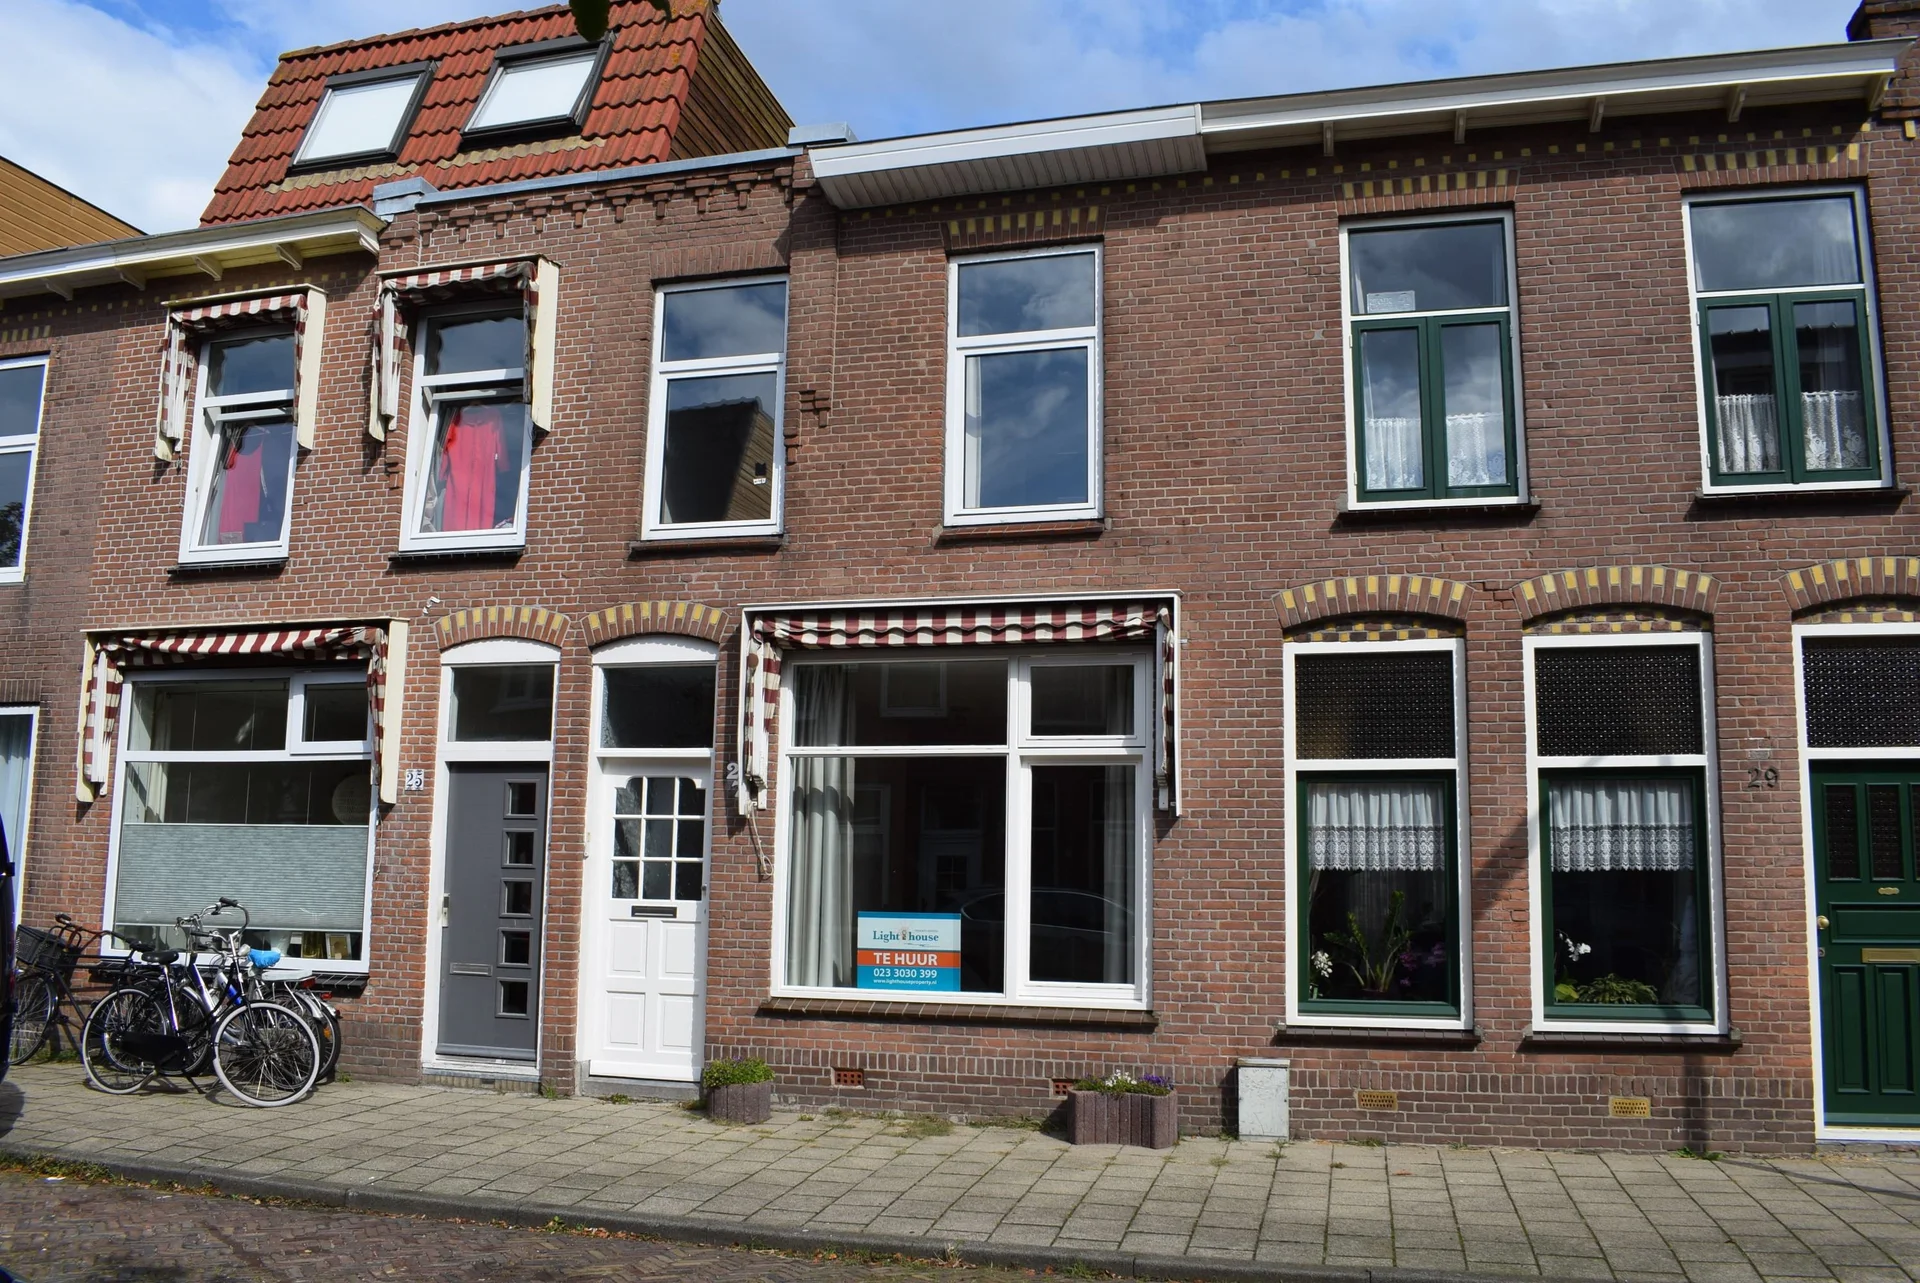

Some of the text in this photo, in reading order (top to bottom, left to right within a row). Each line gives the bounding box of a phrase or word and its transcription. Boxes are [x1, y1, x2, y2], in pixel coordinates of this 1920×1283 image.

[406, 772, 423, 787] 25
[1747, 766, 1778, 788] 29
[873, 930, 939, 943] Light house
[873, 952, 938, 966] TE HUUR
[873, 968, 938, 979] 023 3030 399
